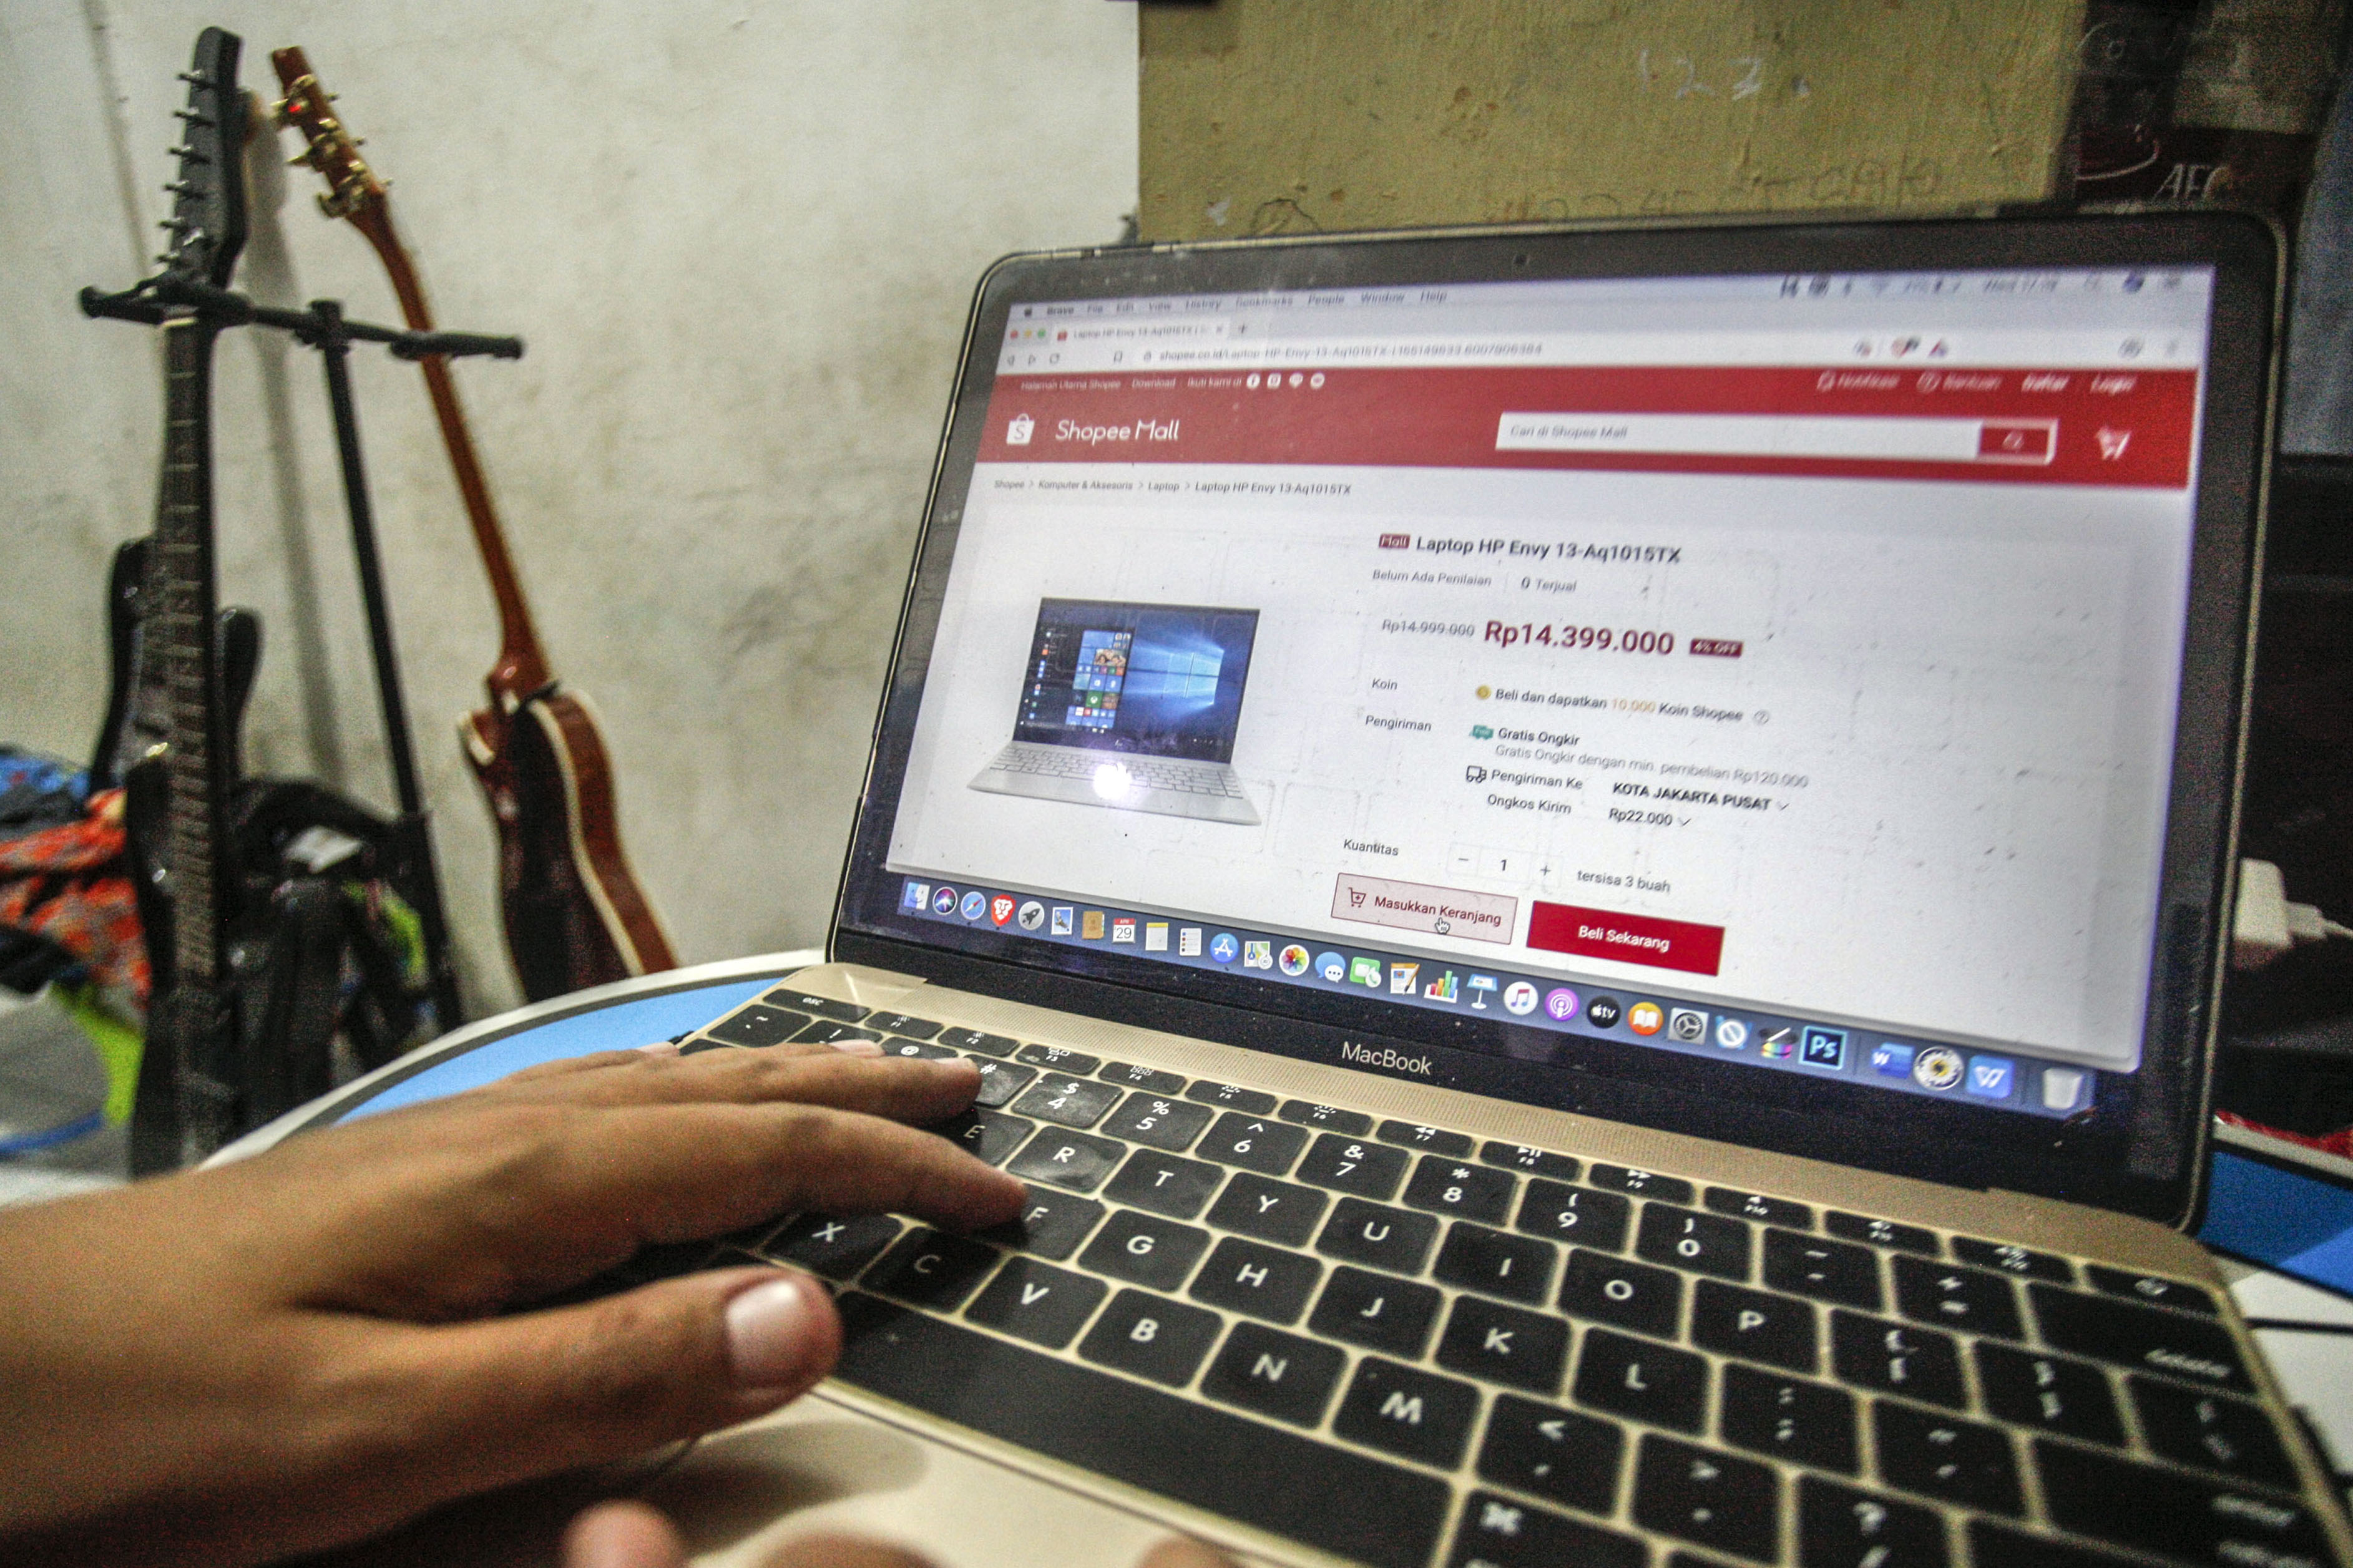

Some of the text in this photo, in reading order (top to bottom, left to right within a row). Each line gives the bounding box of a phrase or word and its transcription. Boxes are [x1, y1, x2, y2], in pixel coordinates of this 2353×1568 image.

[1308, 294, 1345, 306] People
[1361, 291, 1406, 304] Window
[1420, 290, 1447, 303] Help
[1055, 419, 1180, 446] Shopee Mall
[994, 479, 1025, 492] Shopee
[1039, 479, 1079, 492] Komputer
[1148, 480, 1180, 493] Laptop
[1195, 481, 1230, 494] Laptop
[1233, 482, 1249, 492] HP
[1251, 482, 1276, 495] Envy
[1416, 536, 1682, 563] Laptop HP Envy 13-Aq1015TX
[1372, 568, 1492, 587] Belum Ada Penilaian
[1520, 577, 1578, 593] 0 Terjual
[1381, 618, 1675, 656] Rp14.999.000 Rp14.399.000
[1372, 678, 1398, 690] Koin
[1495, 688, 1744, 723] Beli dan dapatkan 10.000 Koin Shopee
[1366, 714, 1432, 731] Pengiriman
[1499, 727, 1580, 747] Gratis Ongkir
[1495, 744, 1532, 759] Gratis
[1534, 747, 1575, 765] Ongkir
[1578, 752, 1627, 771] dengan
[1660, 762, 1731, 781] pembelian
[1733, 769, 1810, 789] Rp120.000
[1491, 768, 1583, 791] Pengiriman Ke
[1487, 794, 1572, 814] Ongkos Kirim
[1612, 782, 1773, 812] KOTA JAKARTA PUSAT
[1608, 807, 1673, 826] Rp22.000
[1343, 839, 1399, 857] Kuantitas
[1500, 859, 1508, 872] 1
[1577, 870, 1671, 894] tersisa 3 buah
[1374, 895, 1502, 927] Masukkan Keranjang
[1116, 927, 1132, 939] 29
[1578, 925, 1671, 953] Beli Sekarang
[1600, 1005, 1617, 1020] tv
[901, 1046, 919, 1056] @
[1809, 1035, 1839, 1059] Ps
[1341, 1041, 1432, 1077] MacBook
[1047, 1096, 1067, 1110] 4
[1152, 1100, 1170, 1116] %
[963, 1124, 986, 1140] E
[1135, 1117, 1158, 1131] 5
[1053, 1146, 1075, 1163] R
[1233, 1139, 1251, 1153] 6
[1155, 1170, 1175, 1187] T
[1336, 1161, 1357, 1177] 7
[1258, 1195, 1279, 1214] Y
[1442, 1186, 1463, 1203] 8
[1025, 1205, 1050, 1222] F
[1557, 1210, 1579, 1229] 9
[812, 1221, 846, 1243] X
[1362, 1221, 1391, 1242] U
[1126, 1234, 1155, 1255] G
[914, 1254, 941, 1274] C
[1236, 1263, 1269, 1288] H
[1020, 1283, 1050, 1305] V
[1361, 1297, 1384, 1318] J
[1130, 1318, 1159, 1342] B
[1738, 1309, 1766, 1332] P
[1482, 1327, 1515, 1355] K
[1251, 1353, 1288, 1382] N
[1625, 1363, 1648, 1391] L
[1380, 1391, 1424, 1424] M
